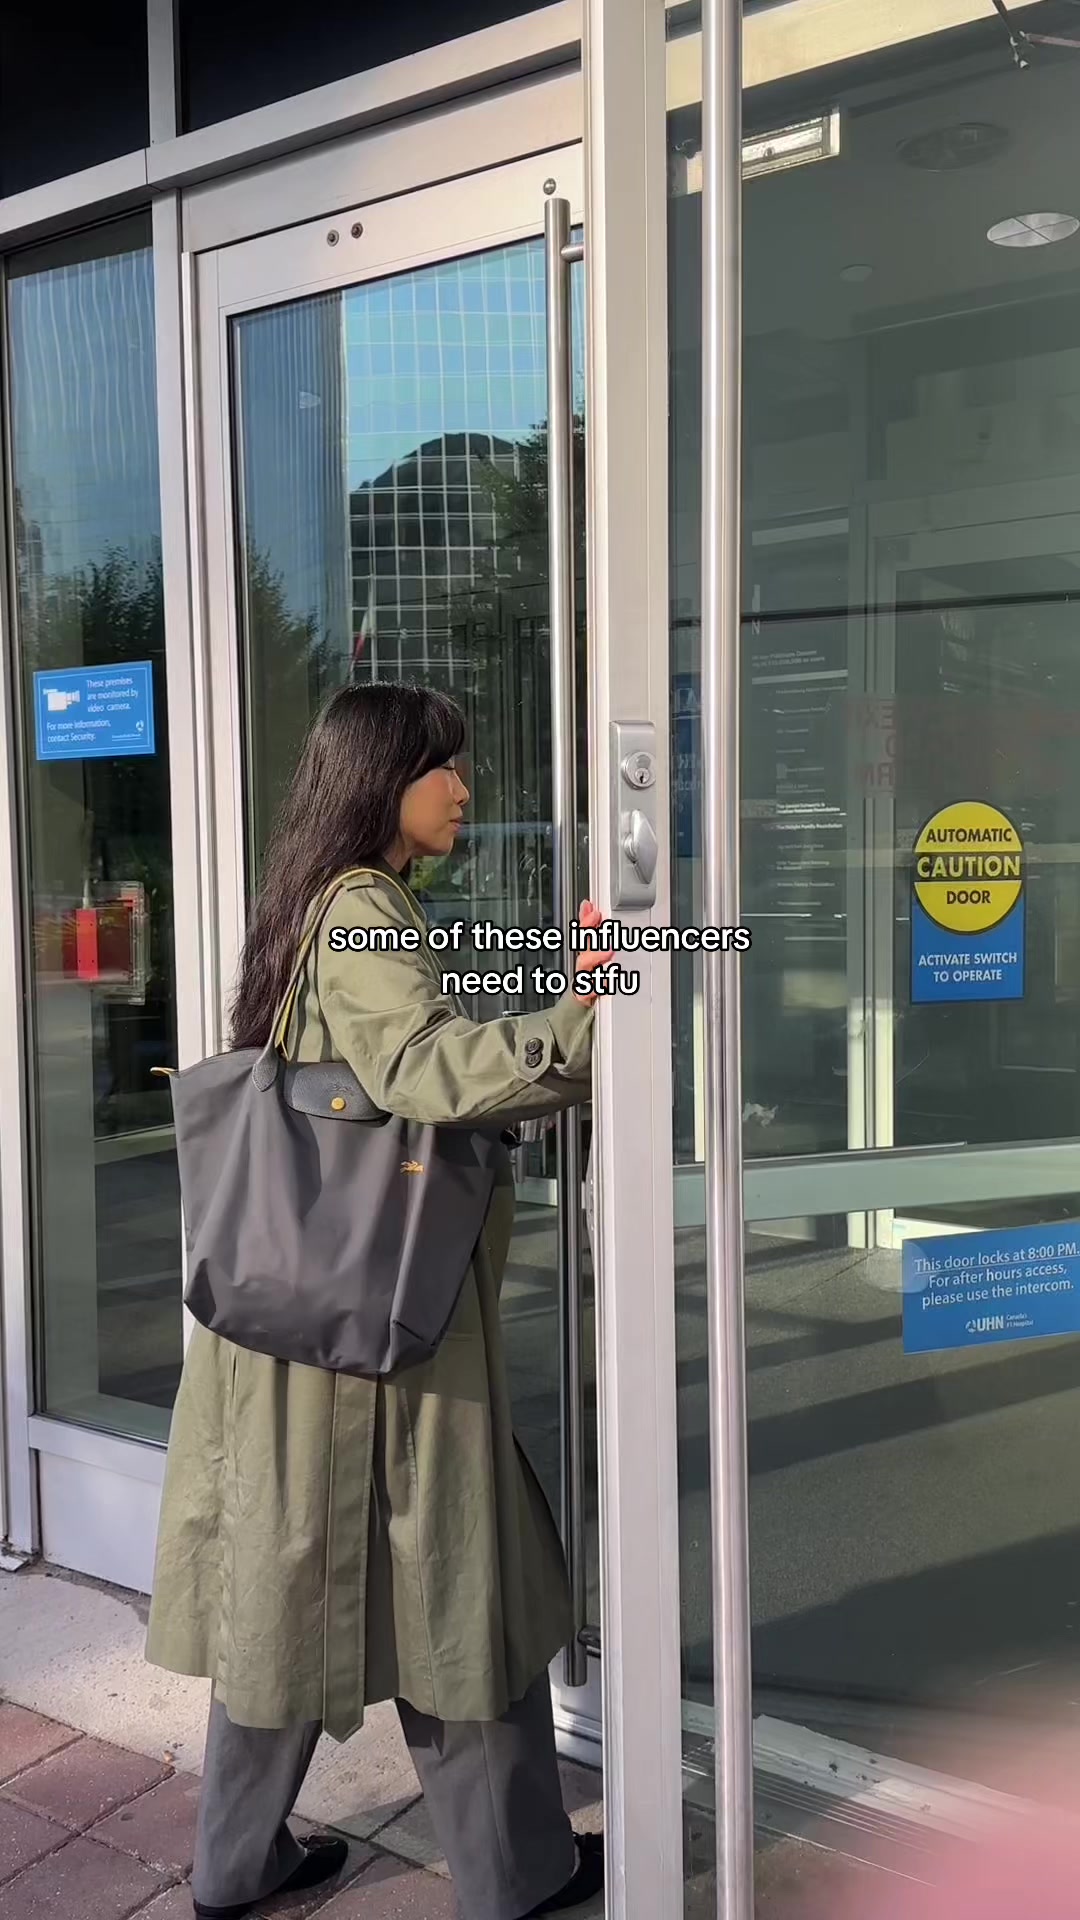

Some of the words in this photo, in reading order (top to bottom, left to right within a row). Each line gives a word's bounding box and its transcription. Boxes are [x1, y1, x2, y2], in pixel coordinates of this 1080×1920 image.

[86, 680, 104, 688] These
[105, 677, 133, 688] premises
[98, 690, 130, 700] monitored
[131, 690, 138, 698] by
[88, 704, 104, 712] video
[107, 704, 131, 712] camera.
[47, 722, 56, 730] For
[58, 722, 73, 730] more
[74, 719, 111, 728] information,
[48, 734, 70, 742] contact
[70, 732, 96, 742] Security.
[926, 828, 1012, 843] AUTOMATIC
[917, 855, 1020, 878] CAUTION
[946, 890, 991, 904] DOOR
[919, 953, 970, 966] ACTIVATE
[974, 952, 1018, 964] SWITCH
[934, 971, 949, 982] TO
[952, 969, 1002, 982] OPERATE
[914, 1258, 941, 1272] This
[944, 1254, 975, 1268] door
[978, 1250, 1010, 1265] locks
[1013, 1249, 1025, 1261] at
[1028, 1245, 1054, 1260] 8:00
[1058, 1242, 1080, 1256] PM.
[929, 1274, 950, 1288] For
[953, 1270, 984, 1285] after
[986, 1267, 1022, 1282] hours
[1025, 1264, 1068, 1278] access,
[922, 1292, 964, 1310] please
[966, 1289, 988, 1301] use
[992, 1284, 1013, 1298] the
[1016, 1280, 1074, 1296] intercom.
[976, 1316, 1004, 1332] UHN
[1013, 1320, 1034, 1328] Hospital
